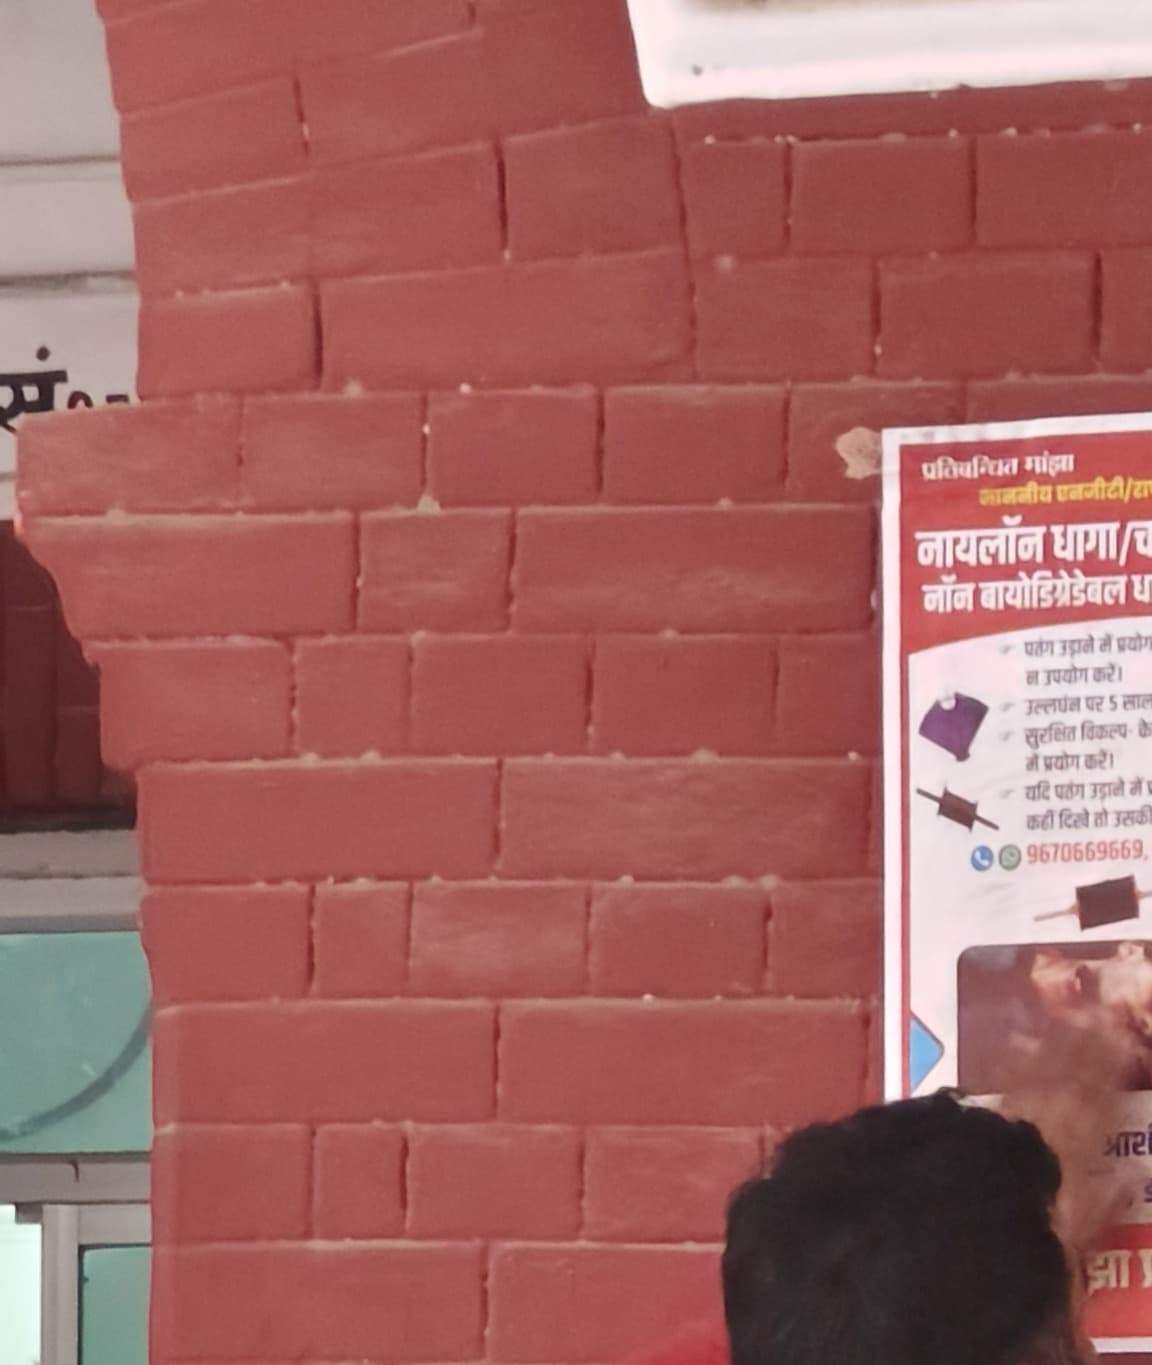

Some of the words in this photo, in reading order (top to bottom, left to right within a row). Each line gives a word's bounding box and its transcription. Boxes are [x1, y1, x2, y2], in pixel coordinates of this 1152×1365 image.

[1024, 450, 1074, 477] मांझा
[915, 514, 1047, 569] नायलॉन
[922, 573, 976, 614] नॉन
[979, 569, 1127, 610] बायोडिग्रेडेबल
[1116, 632, 1152, 652] प्रयोग
[1026, 670, 1039, 686] न
[1043, 663, 1089, 686] उपयोग
[1085, 695, 1104, 713] पर
[1109, 695, 1118, 711] 5
[1024, 721, 1076, 749] सुरक्षित
[1043, 751, 1080, 772] प्रयोग
[1024, 780, 1050, 801] यदि
[1059, 807, 1090, 829] दिखे
[1094, 807, 1108, 828] तो
[1113, 804, 1152, 827] उसकी
[1026, 838, 1148, 865] 9670669669,
